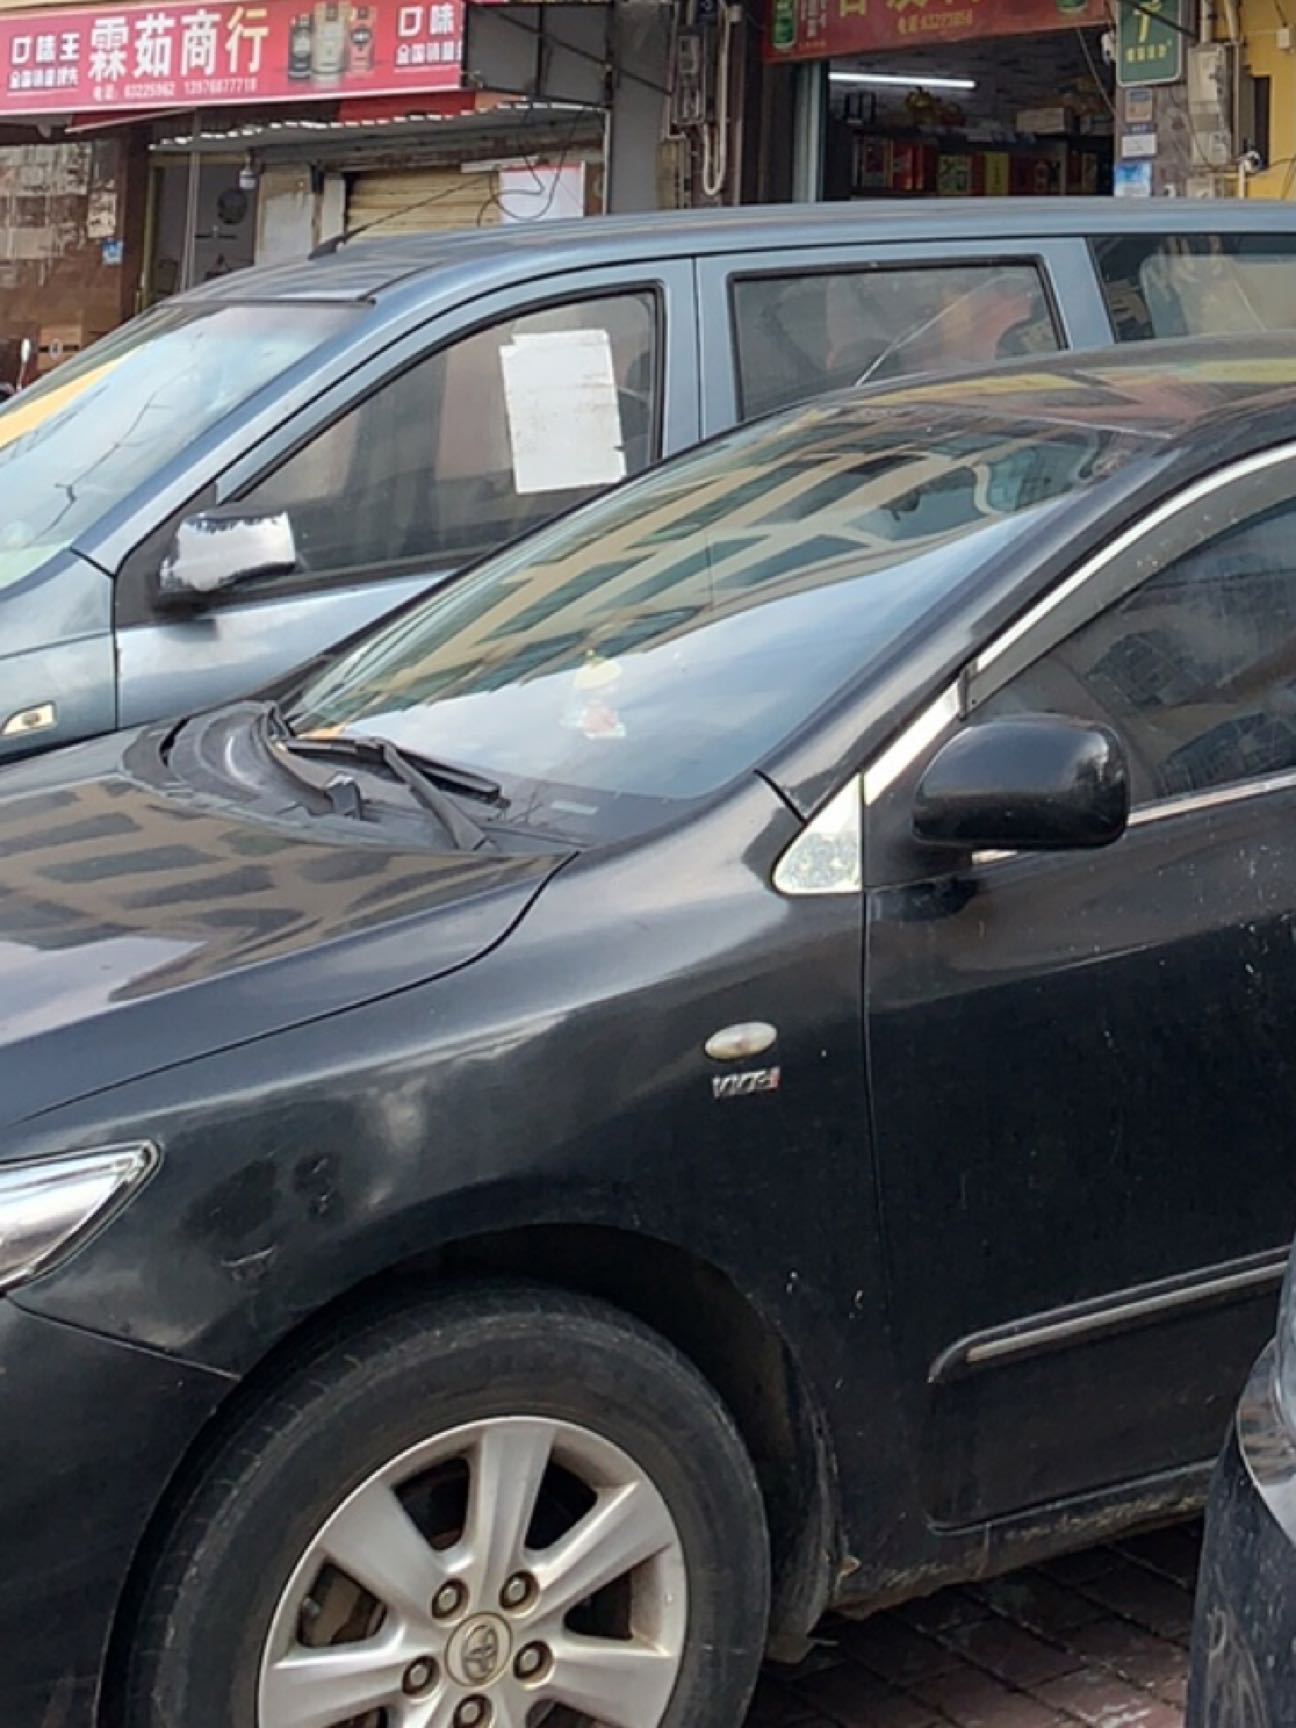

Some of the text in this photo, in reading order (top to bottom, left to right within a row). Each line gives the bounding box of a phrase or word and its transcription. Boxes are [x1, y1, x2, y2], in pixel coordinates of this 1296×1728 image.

[88, 6, 270, 81] 霖茹商行
[398, 2, 463, 37] 口味
